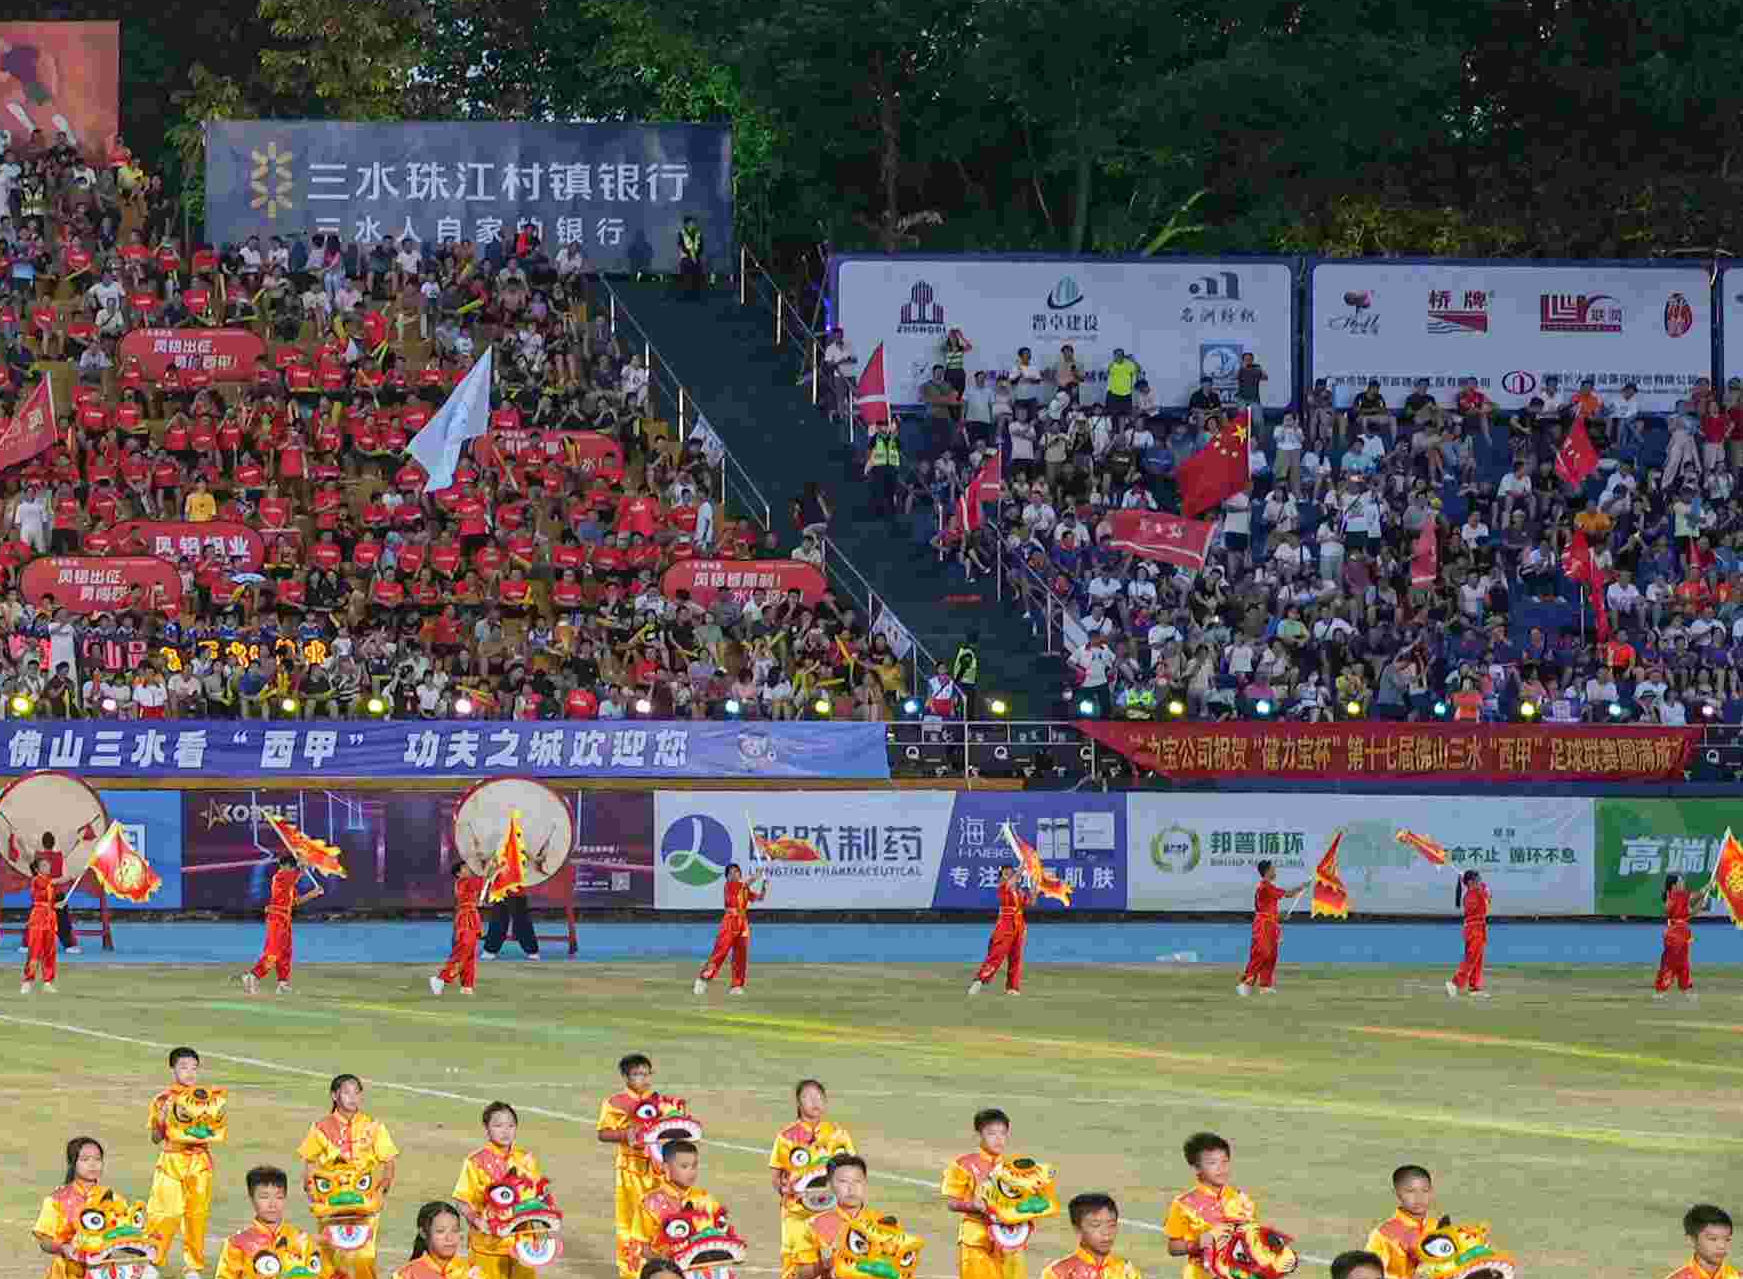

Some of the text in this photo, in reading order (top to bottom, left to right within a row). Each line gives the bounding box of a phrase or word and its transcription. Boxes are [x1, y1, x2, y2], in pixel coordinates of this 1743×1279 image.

[308, 161, 689, 202] 三水珠江村镇银行
[403, 729, 690, 769] 功夫之城欢迎您
[1444, 847, 1502, 864] 命不止
[1618, 835, 1724, 876] 高端
[815, 866, 924, 878] PHARMACEUTICAL
[949, 866, 1116, 889] 专注肌肤
